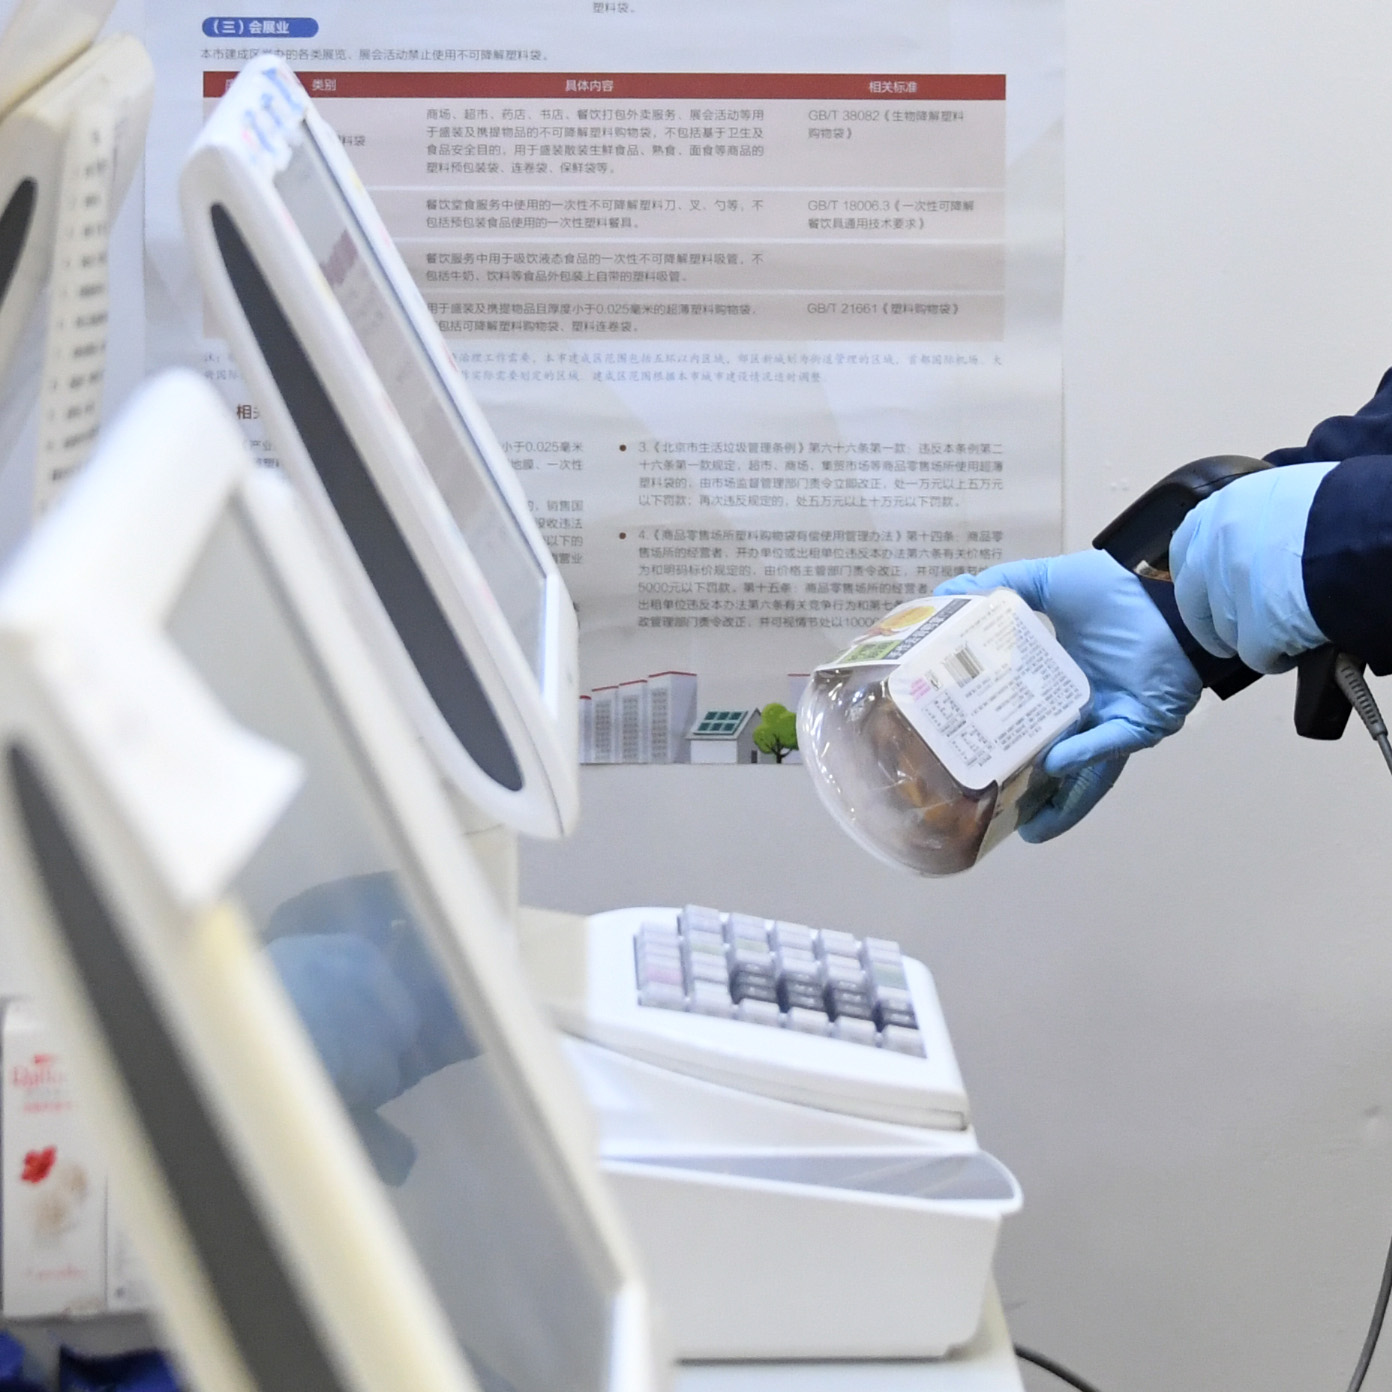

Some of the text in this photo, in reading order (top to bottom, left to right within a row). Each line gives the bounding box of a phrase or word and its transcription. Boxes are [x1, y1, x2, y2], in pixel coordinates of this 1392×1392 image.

[592, 1, 635, 14] 塑料袋。
[312, 79, 337, 92] 类别
[564, 80, 614, 93] 具体内容
[869, 80, 917, 94] 相关标准
[808, 110, 838, 122] GB/T
[808, 200, 838, 213] GB/T
[807, 303, 837, 315] GB/T
[436, 320, 639, 333] 包括可降解塑料购物袋、塑料连卷袋。
